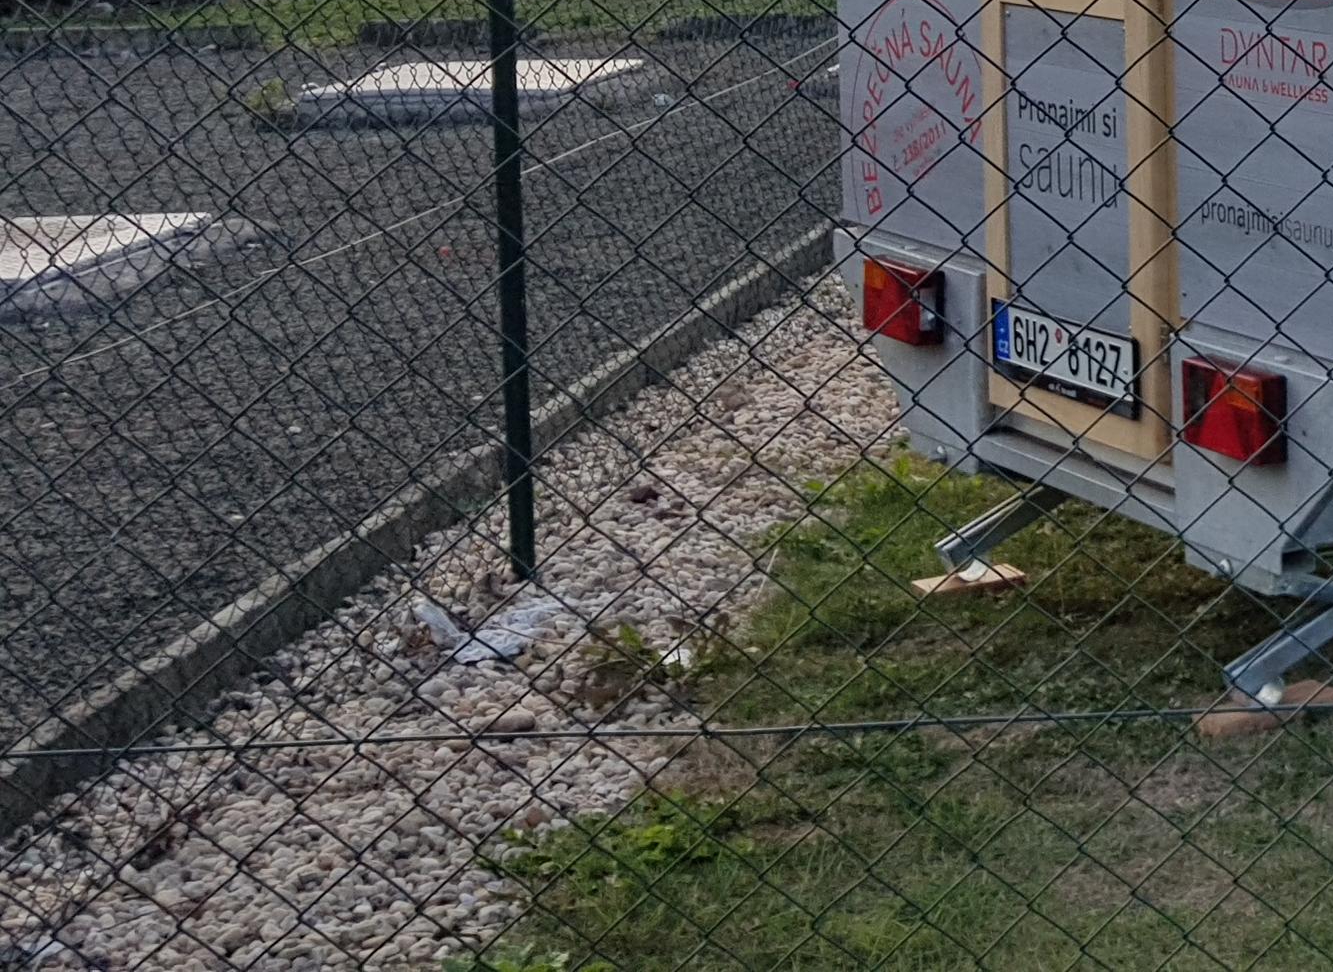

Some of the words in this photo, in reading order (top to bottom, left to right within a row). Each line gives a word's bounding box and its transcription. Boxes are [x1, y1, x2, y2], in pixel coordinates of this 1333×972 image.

[1221, 28, 1328, 78] DYNTAR
[920, 20, 982, 144] SAUNA
[1222, 73, 1259, 92] AUNA
[1018, 91, 1096, 138] Pronajmi
[1102, 108, 1117, 139] si
[1020, 143, 1118, 209] saunu
[1013, 316, 1050, 366] 6H2
